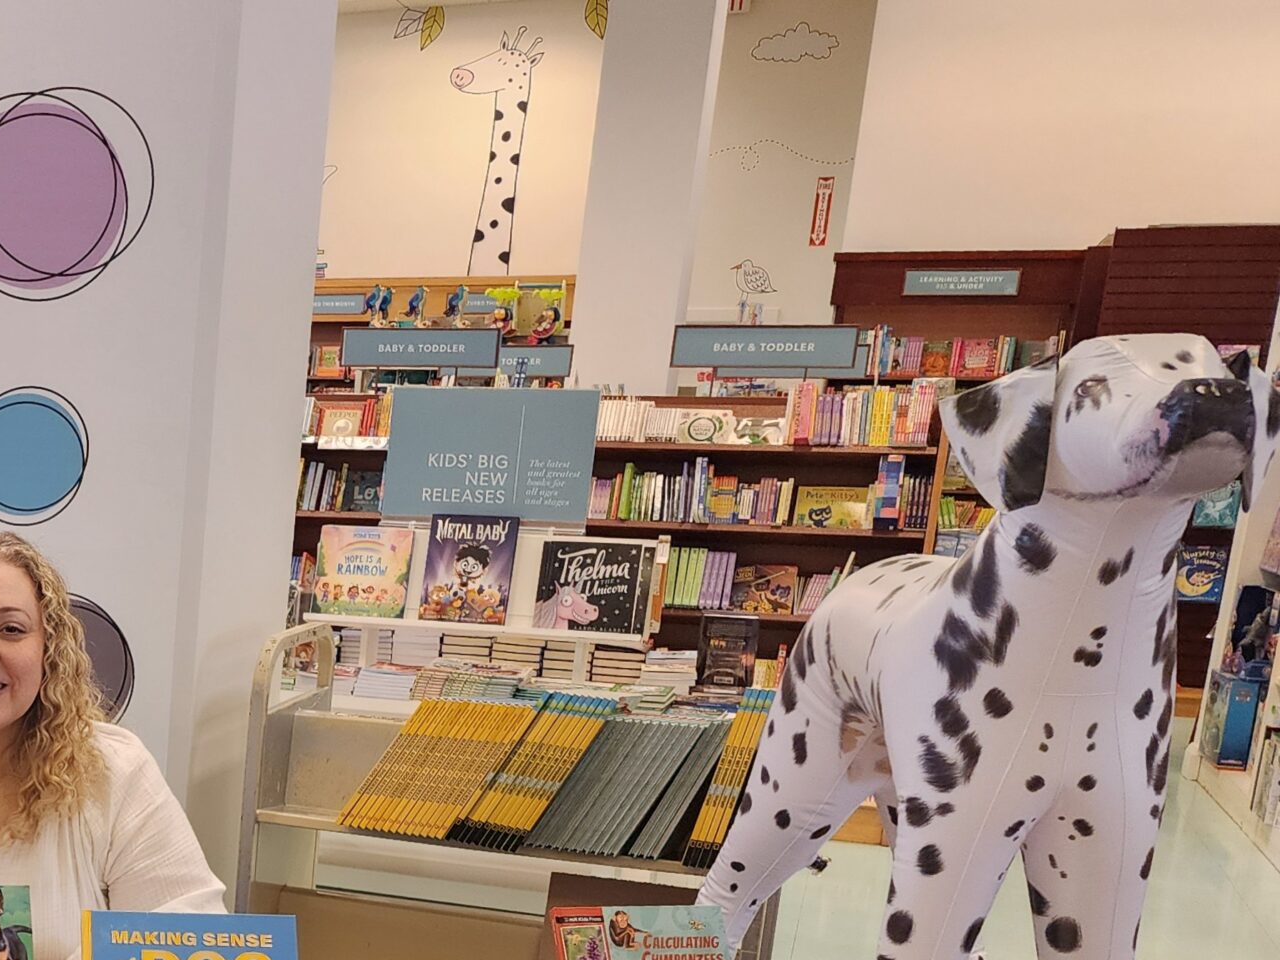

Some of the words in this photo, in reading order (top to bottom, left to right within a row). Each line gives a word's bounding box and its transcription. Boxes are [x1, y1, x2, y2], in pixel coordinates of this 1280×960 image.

[378, 344, 405, 353] BABY
[408, 344, 415, 352] &
[418, 344, 466, 353] TODDLER
[713, 343, 744, 352] BABY
[748, 343, 756, 352] &
[760, 343, 815, 352] TODDLER
[428, 453, 473, 468] KIDS'
[479, 455, 508, 469] BIG
[547, 460, 570, 468] latest
[465, 472, 507, 486] NEW
[551, 479, 564, 488] for
[422, 488, 505, 504] RELEASES
[544, 499, 569, 507] stages
[435, 518, 473, 544] METAL
[475, 519, 511, 546] BABY
[345, 555, 362, 563] HOPE
[366, 555, 373, 563] IS
[558, 548, 630, 583] Thelma
[337, 563, 388, 576] RAINBOW
[585, 581, 628, 596] Unicorn
[111, 930, 197, 946] MAKING
[202, 932, 273, 948] SENSE
